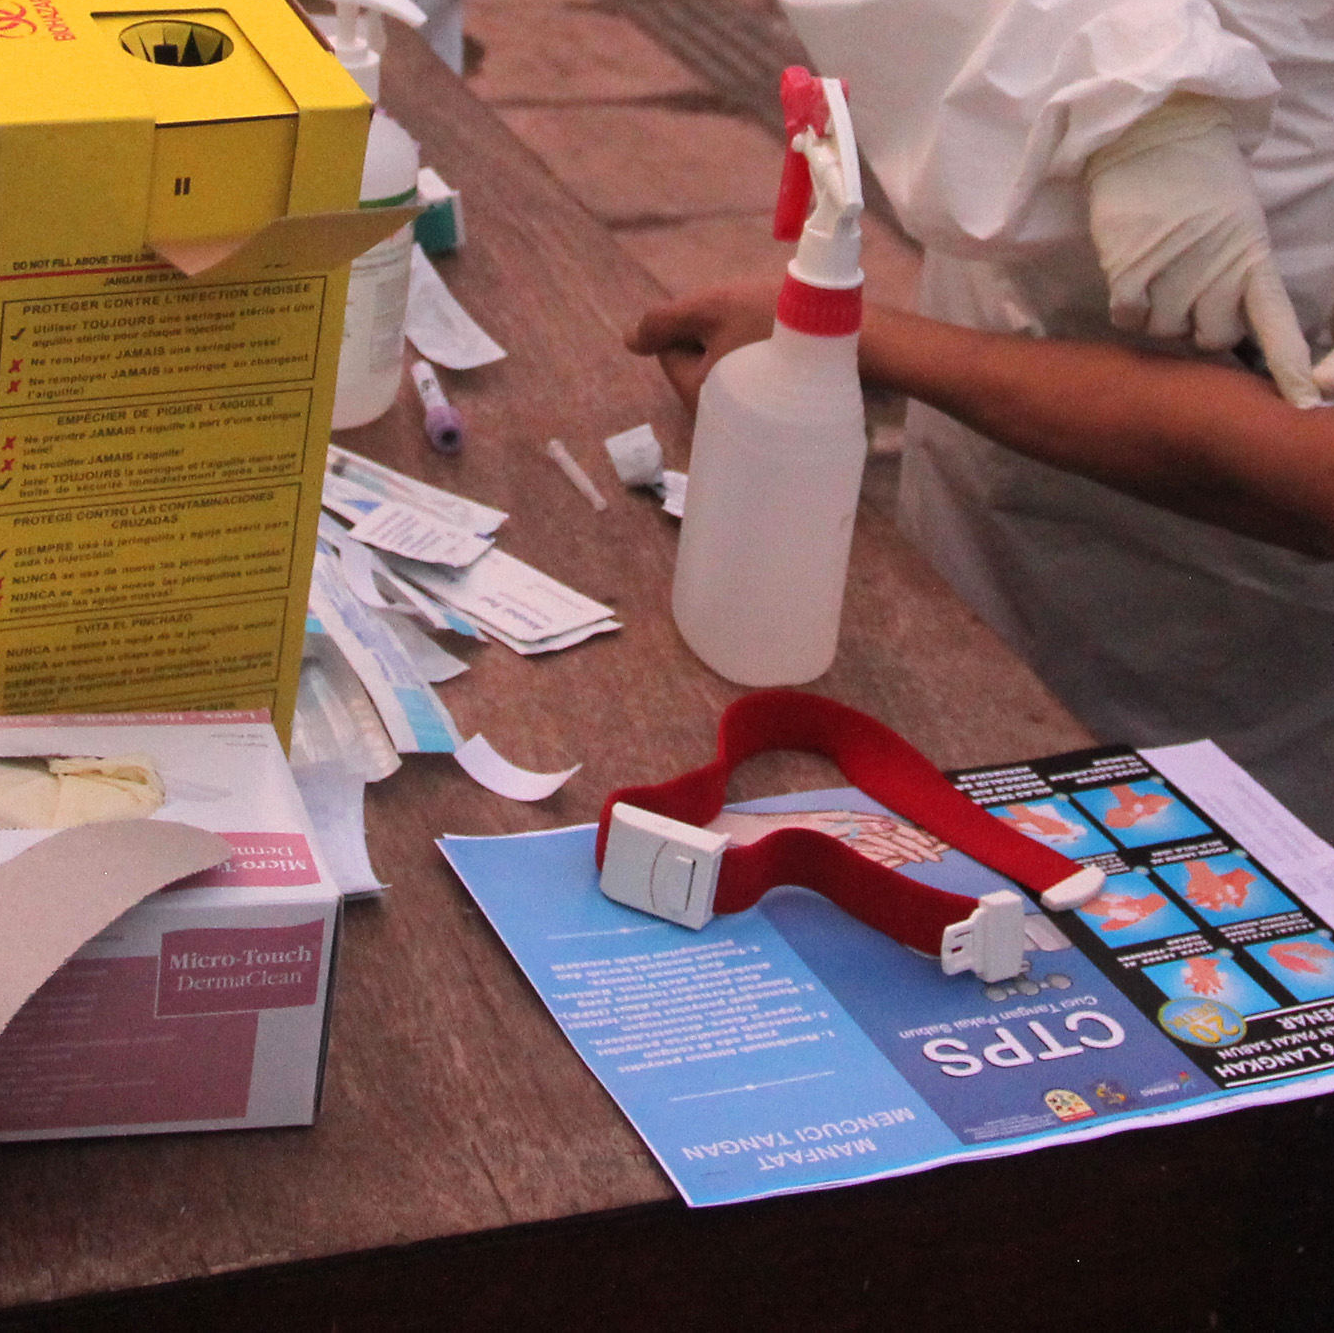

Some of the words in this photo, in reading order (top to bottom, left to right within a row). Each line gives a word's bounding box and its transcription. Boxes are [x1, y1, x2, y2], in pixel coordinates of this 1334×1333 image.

[12, 260, 27, 271] DO
[29, 259, 49, 270] NOT
[51, 257, 71, 268] FILL
[75, 254, 108, 266] ABOVE
[111, 253, 132, 264] THIS
[22, 300, 98, 315] PROTEGER
[104, 295, 159, 308] CONTRE
[165, 288, 248, 303] L'INFECTION
[33, 321, 76, 334] Utiliser
[82, 315, 155, 330] TOUJOURS
[159, 315, 180, 323] une
[184, 309, 235, 323] seringue
[239, 306, 275, 317] stérile
[279, 305, 290, 314] et
[293, 304, 314, 312] une
[115, 347, 164, 360] JAMAIS
[110, 366, 160, 379] JAMAIS
[133, 408, 148, 418] DE
[156, 403, 202, 416] PIQUER
[209, 396, 273, 411] L'AIGUILLE
[89, 426, 136, 438] JAMAIS
[87, 452, 133, 465] JAMAIS
[51, 469, 120, 484] TOUJOURS
[13, 512, 72, 527] PROTEGE
[76, 506, 128, 520] CONTRO
[132, 503, 155, 514] LAS
[160, 491, 274, 511] CONTAMINACIONES
[111, 513, 178, 529] CRUZADAS
[75, 621, 108, 634] EVITA
[112, 619, 125, 629] EL
[131, 611, 193, 627] PINCHAZO
[169, 946, 312, 971] Micro-Touch
[176, 969, 303, 992] DermaClean
[996, 1001, 1062, 1022] Tangan
[1057, 994, 1102, 1011] Cuci
[895, 1021, 954, 1041] Sabun
[950, 1012, 1001, 1031] Pakai
[1187, 1014, 1240, 1043] 20
[912, 1006, 1136, 1080] CTPS
[1215, 1040, 1273, 1058] SABUN
[1269, 1030, 1320, 1047] PAKAI
[1211, 1046, 1322, 1078] LANGKAH
[790, 1104, 917, 1142] MENCUCI
[679, 1128, 793, 1164] TANGAN
[750, 1134, 878, 1173] MANFAAT
